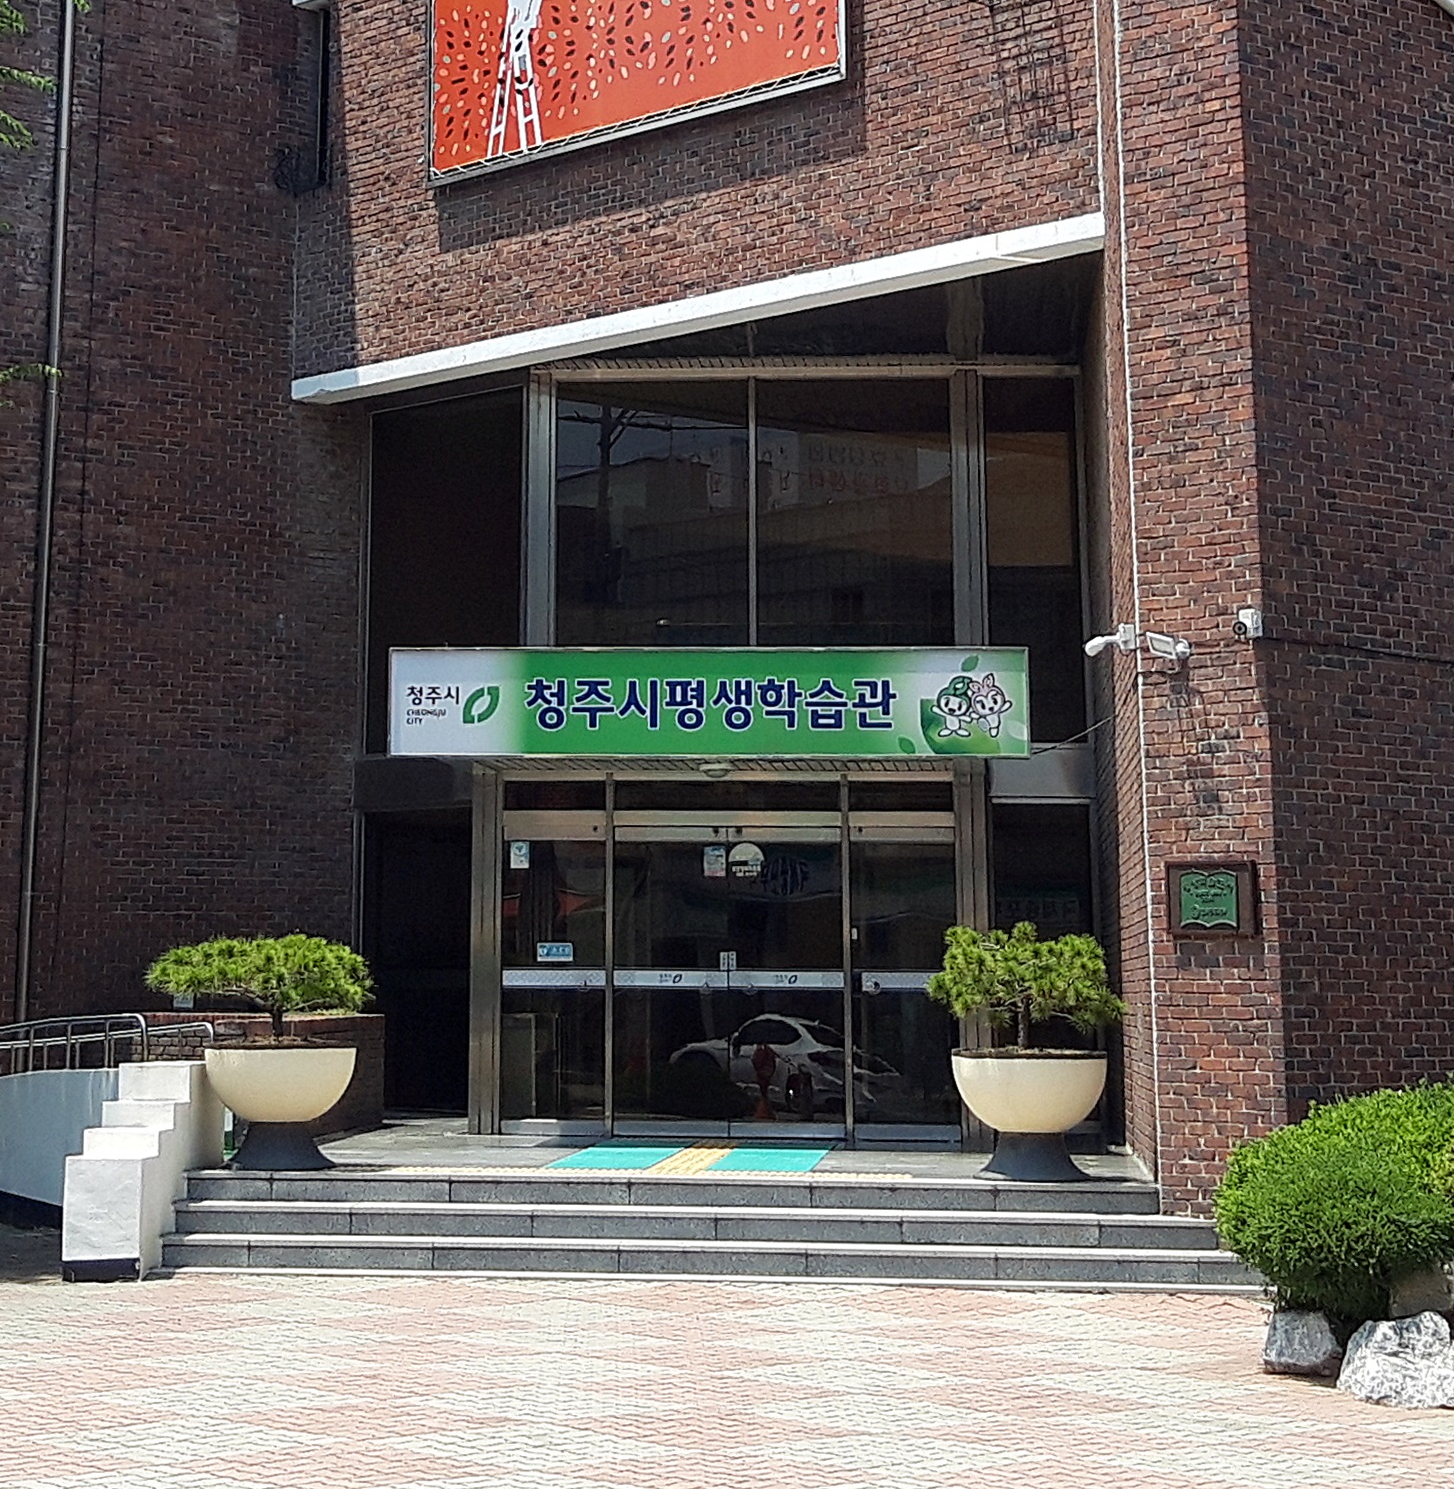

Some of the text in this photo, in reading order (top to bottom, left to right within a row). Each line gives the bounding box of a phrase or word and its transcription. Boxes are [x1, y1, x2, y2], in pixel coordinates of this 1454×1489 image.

[406, 685, 460, 706] 청주시
[525, 678, 897, 730] 청주시평생학습관
[406, 708, 447, 718] CHEONGJU
[406, 717, 423, 725] CITY
